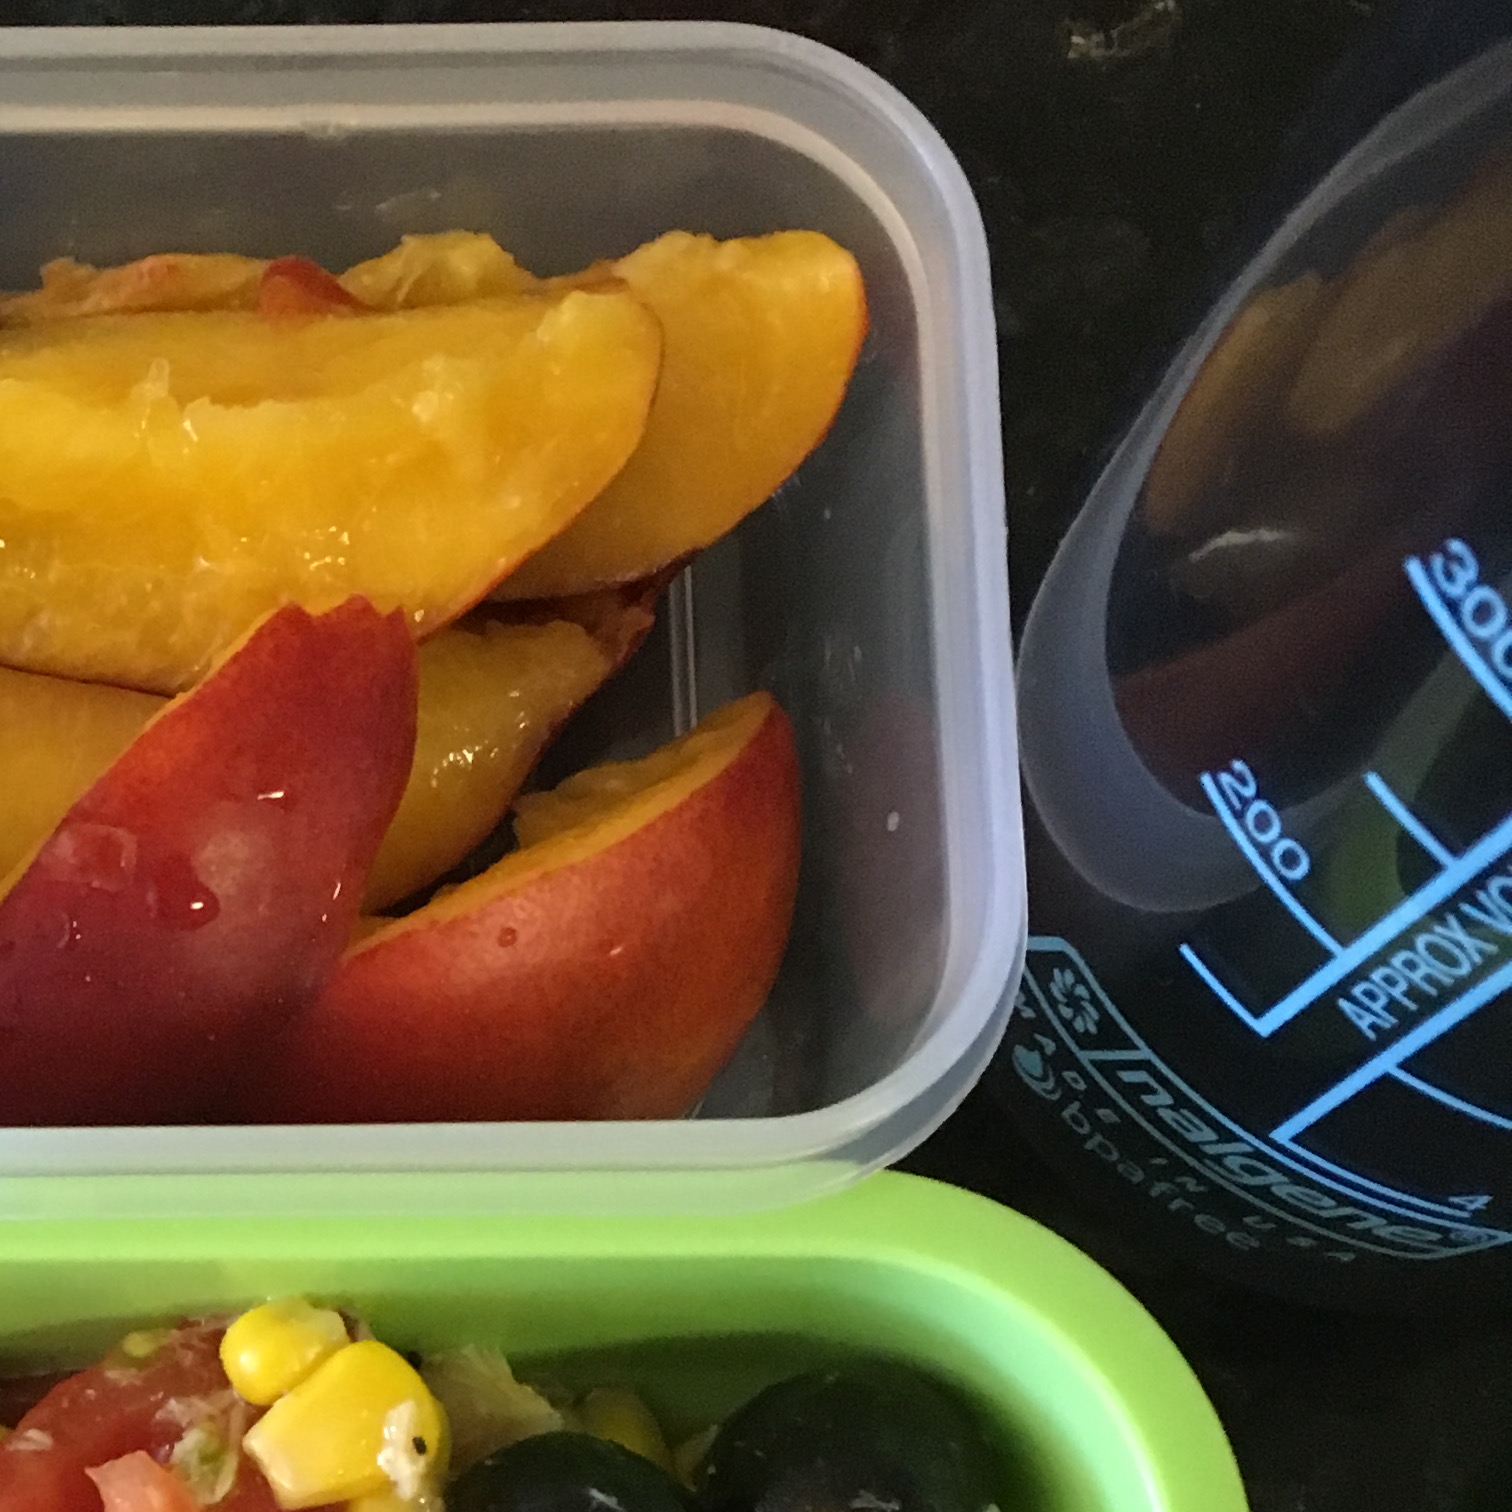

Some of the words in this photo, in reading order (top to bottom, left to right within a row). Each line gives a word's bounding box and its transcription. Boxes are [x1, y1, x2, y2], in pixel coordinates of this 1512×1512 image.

[1218, 760, 1311, 882] 200
[1337, 914, 1500, 1041] APPROX
[1116, 1071, 1443, 1251] nalgene
